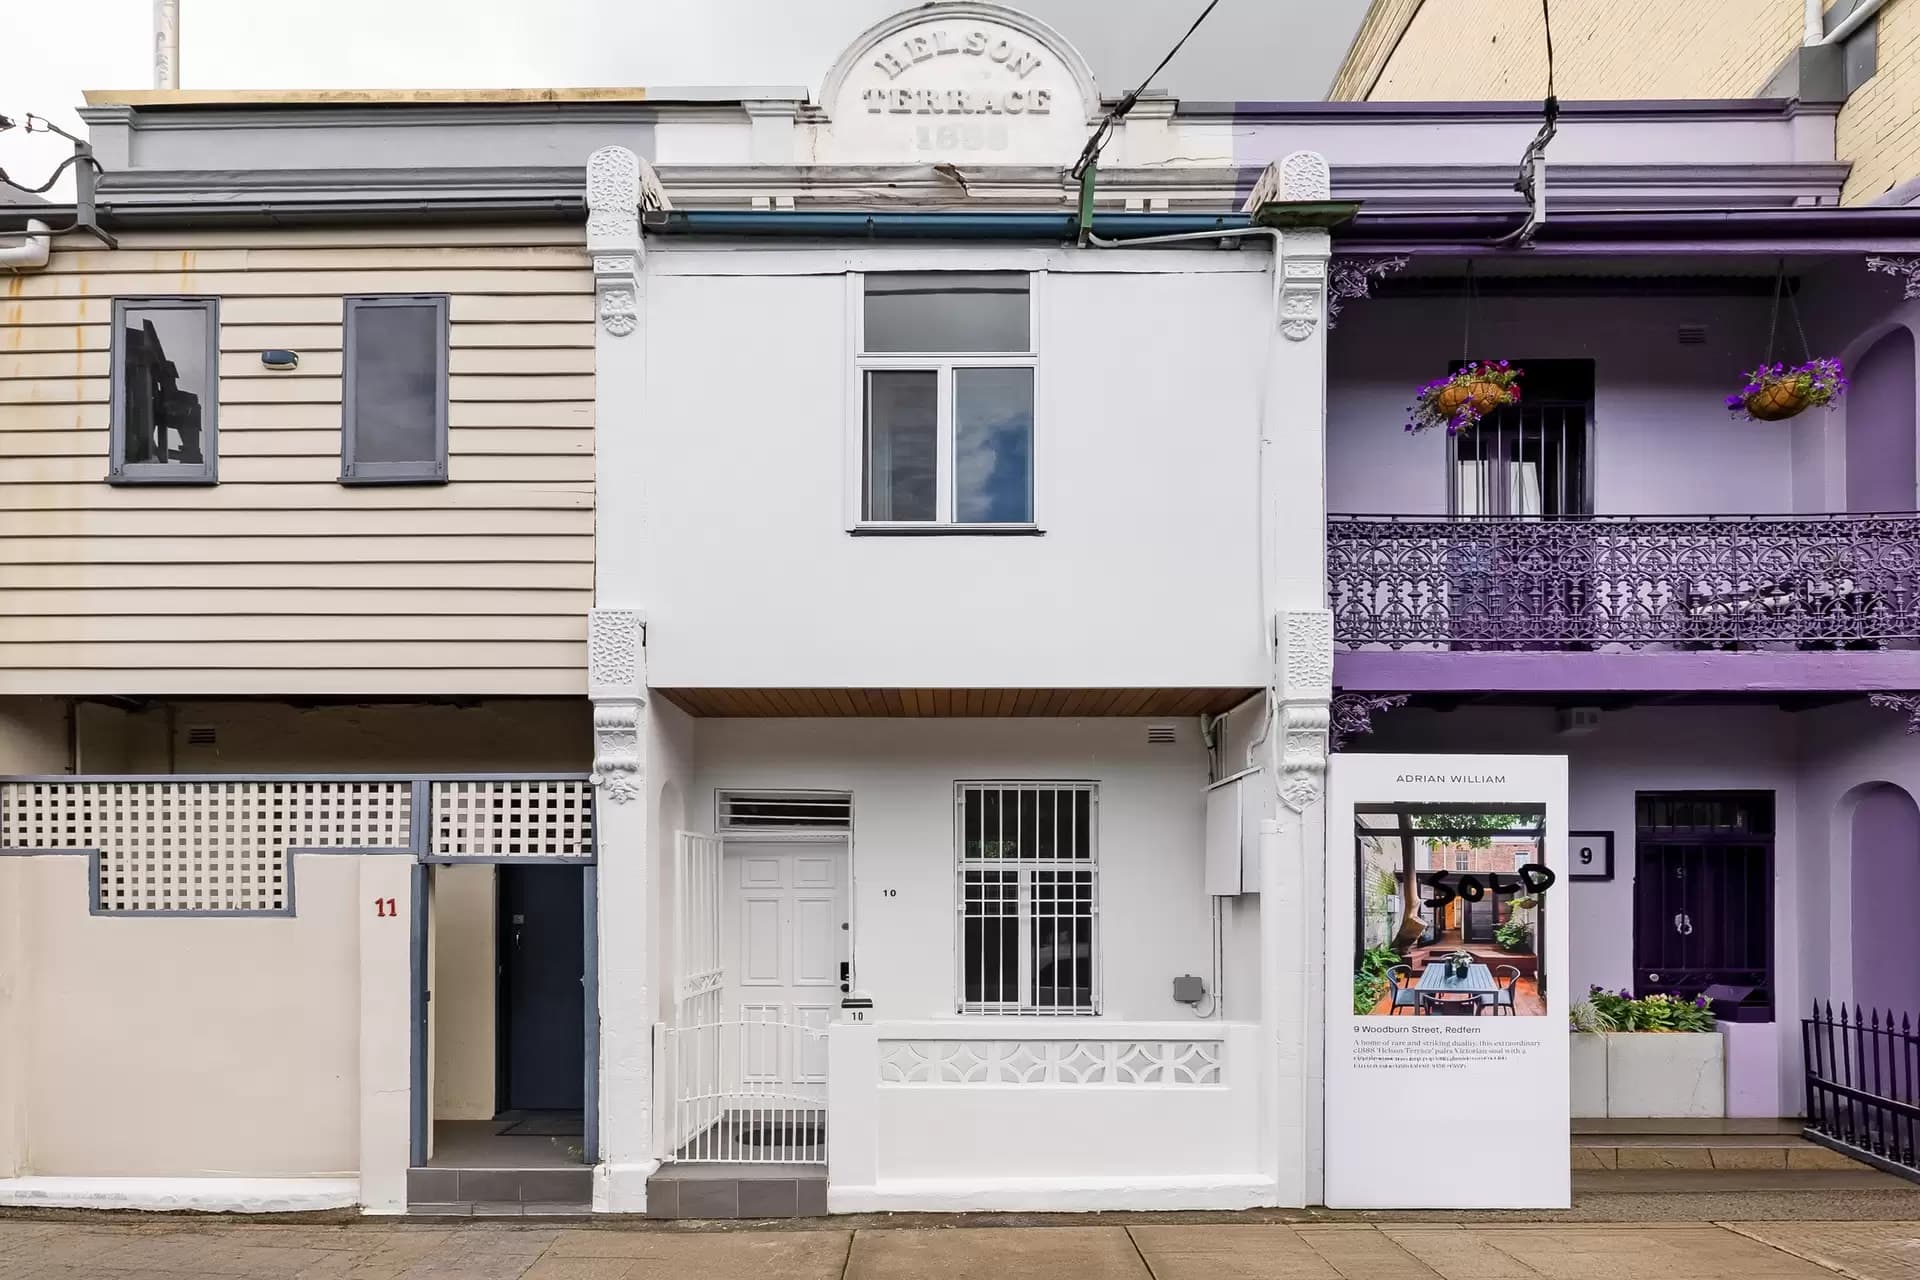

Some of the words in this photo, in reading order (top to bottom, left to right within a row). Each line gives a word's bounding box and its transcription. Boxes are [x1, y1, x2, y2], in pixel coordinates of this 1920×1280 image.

[862, 88, 1051, 115] TERRACE
[1396, 774, 1446, 784] ADRIAN
[1450, 775, 1507, 784] WILLIAM
[1579, 847, 1593, 865] 9
[1423, 863, 1556, 908] SOLD
[882, 889, 897, 898] 10
[374, 897, 398, 918] 11
[851, 1011, 864, 1021] 10
[1353, 1025, 1360, 1033] 9
[1361, 1025, 1410, 1034] Woodburn
[1411, 1025, 1443, 1035] Street,
[1445, 1026, 1481, 1034] Redfern
[1360, 1039, 1381, 1047] home
[1382, 1039, 1390, 1047] of
[1406, 1039, 1421, 1047] and
[1422, 1039, 1451, 1048] striking
[1479, 1040, 1493, 1048] this
[1454, 1048, 1488, 1056] Victorian
